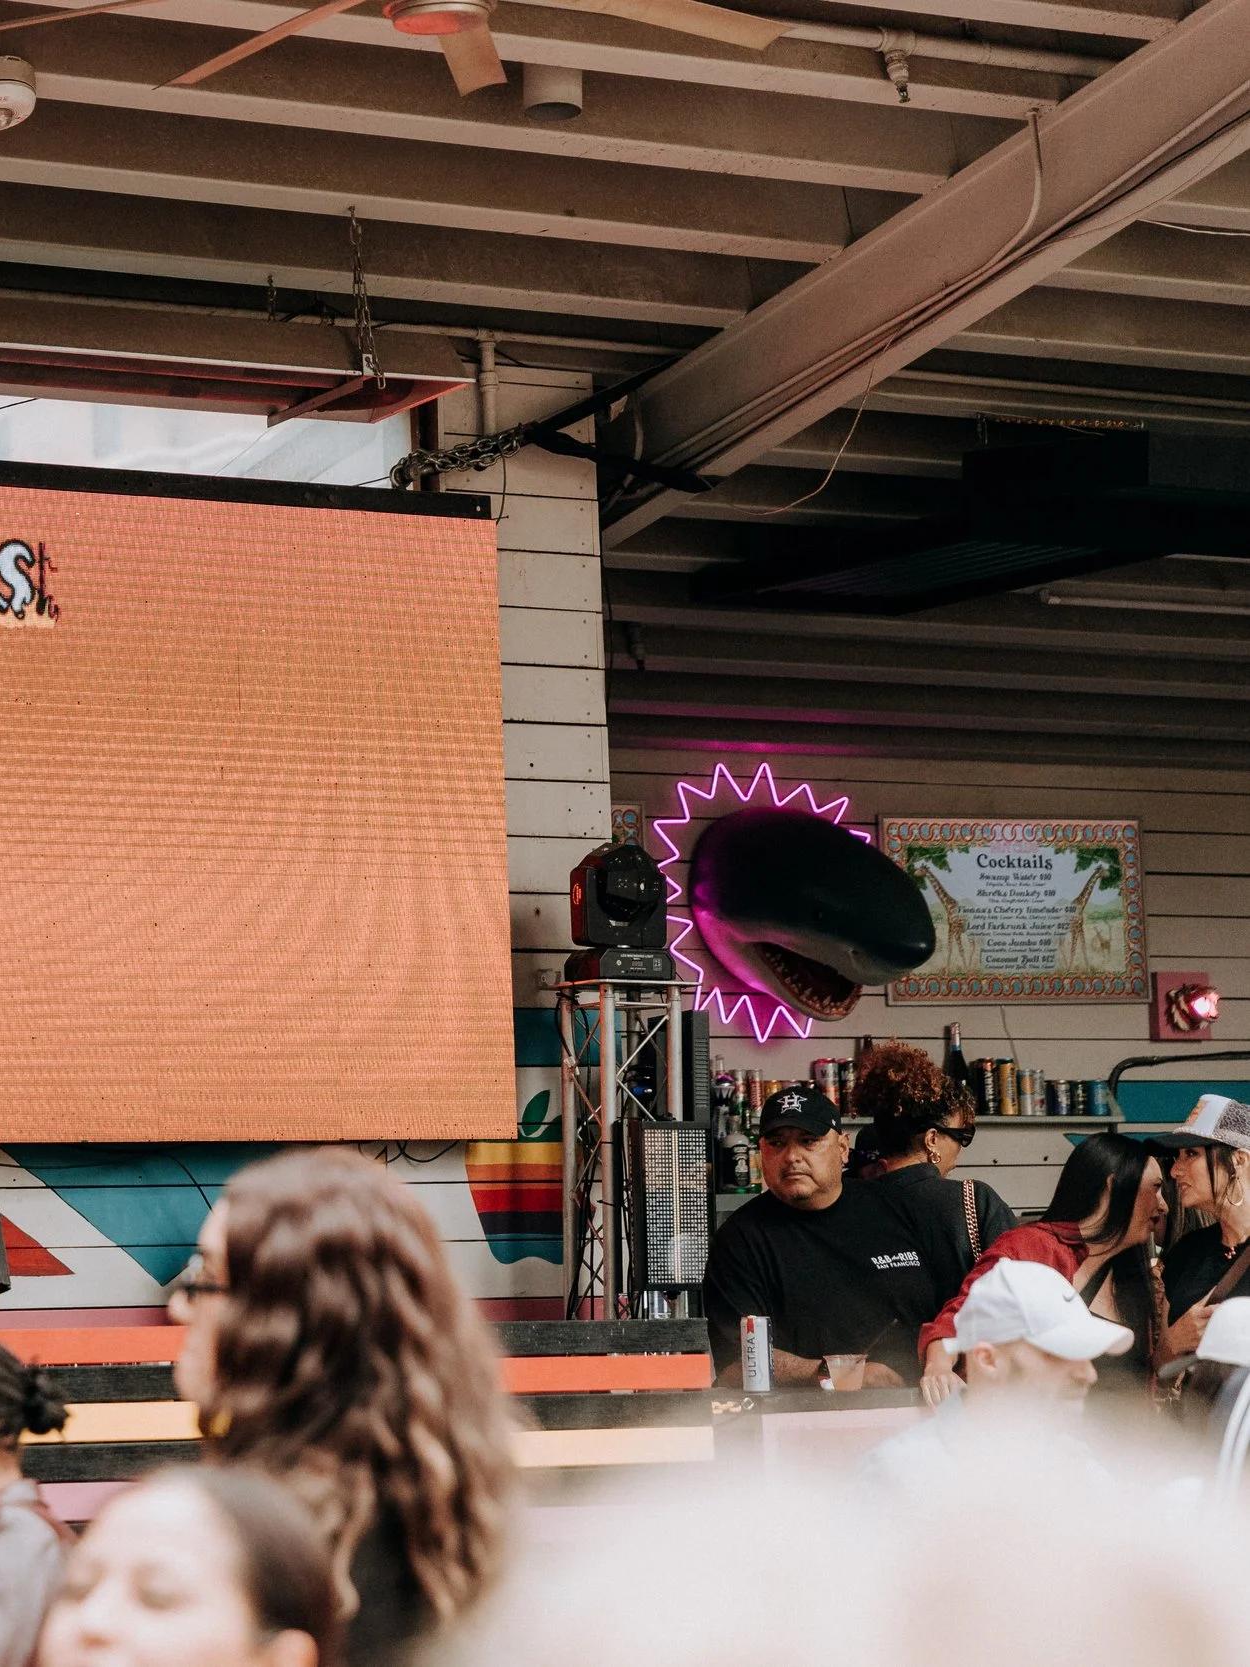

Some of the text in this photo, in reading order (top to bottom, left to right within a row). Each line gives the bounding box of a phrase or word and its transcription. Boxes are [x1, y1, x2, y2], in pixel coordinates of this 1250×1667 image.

[976, 853, 1053, 870] Cocktails
[1010, 889, 1041, 898] Donkey
[993, 906, 1023, 915] Cherry
[966, 922, 985, 930] Lord
[987, 939, 1006, 947] Coco
[984, 1071, 995, 1101] TRULY
[871, 1255, 892, 1265] R&B
[898, 1251, 919, 1261] RIBS
[890, 1260, 920, 1268] FRANCISCO
[747, 1337, 757, 1378] ULTRA
